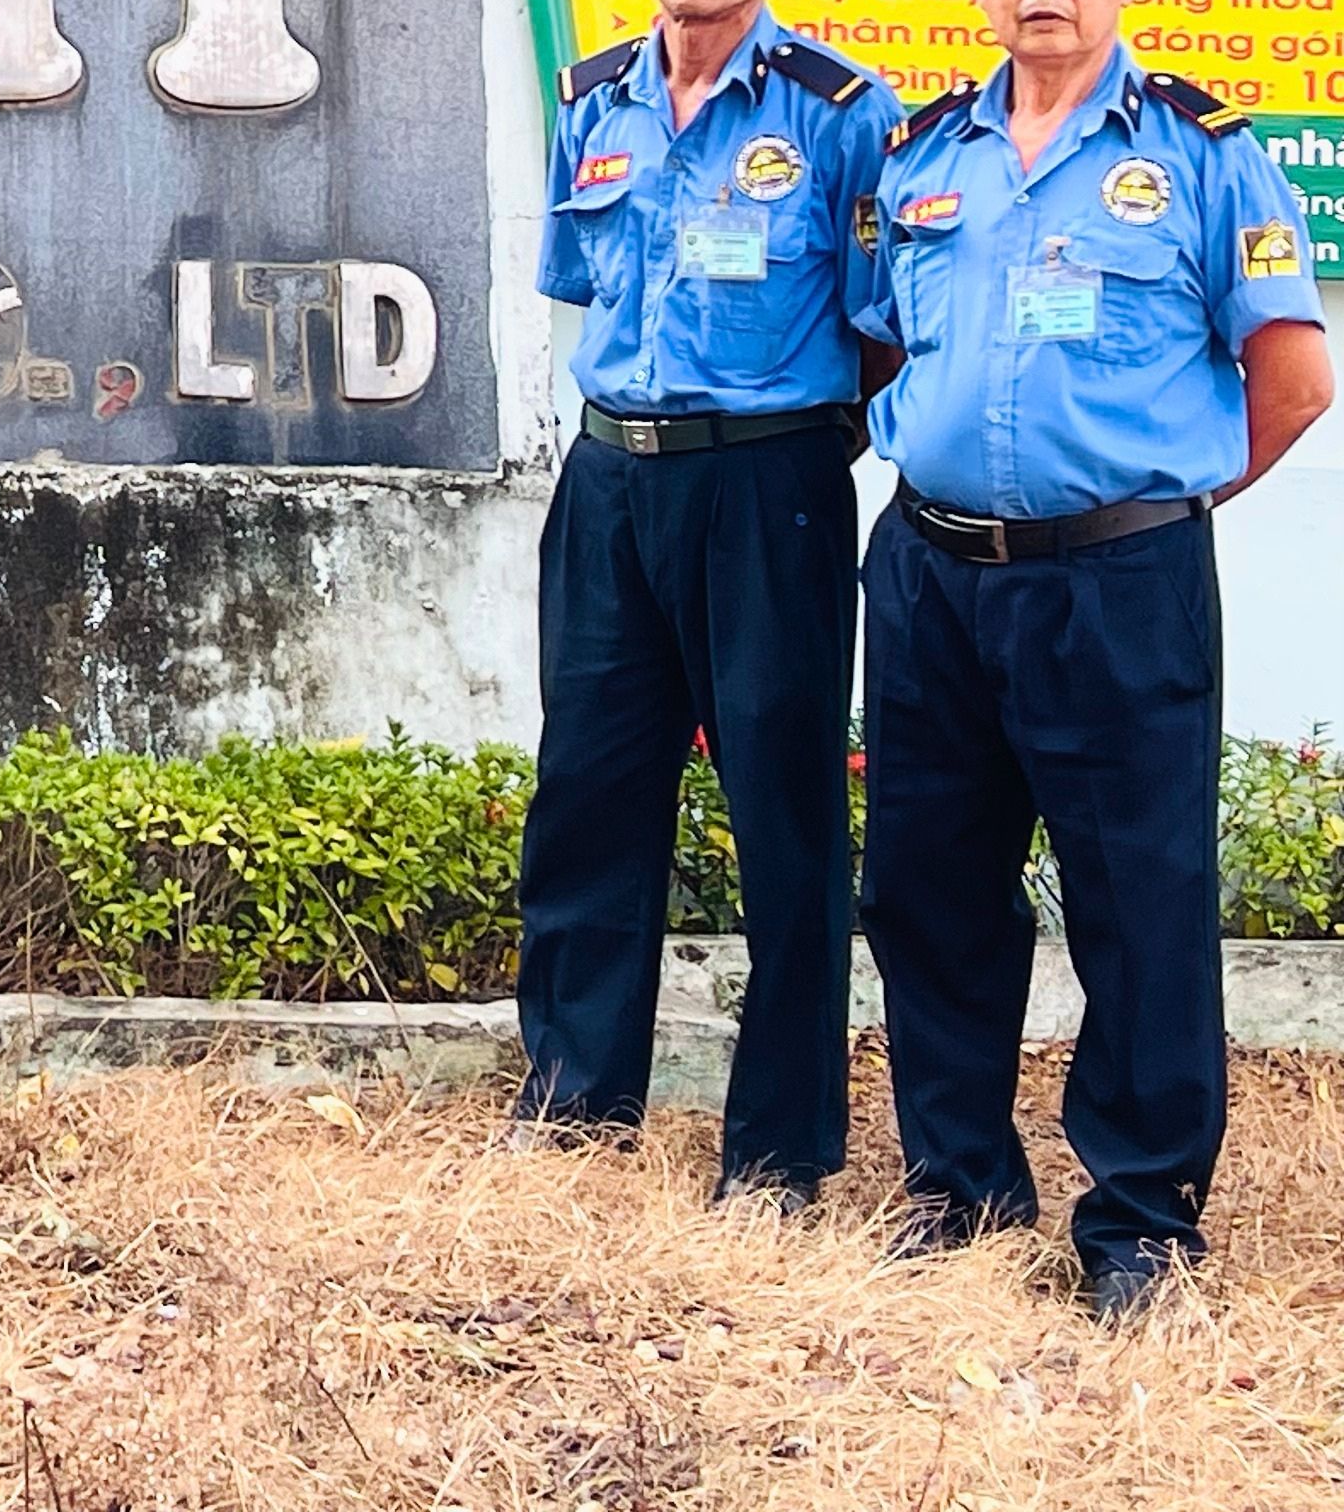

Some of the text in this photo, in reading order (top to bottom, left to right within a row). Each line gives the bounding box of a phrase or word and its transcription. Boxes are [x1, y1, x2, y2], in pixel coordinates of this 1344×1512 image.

[794, 17, 920, 46] nhân
[1133, 26, 1252, 60] đóng
[174, 259, 438, 404] LTD
